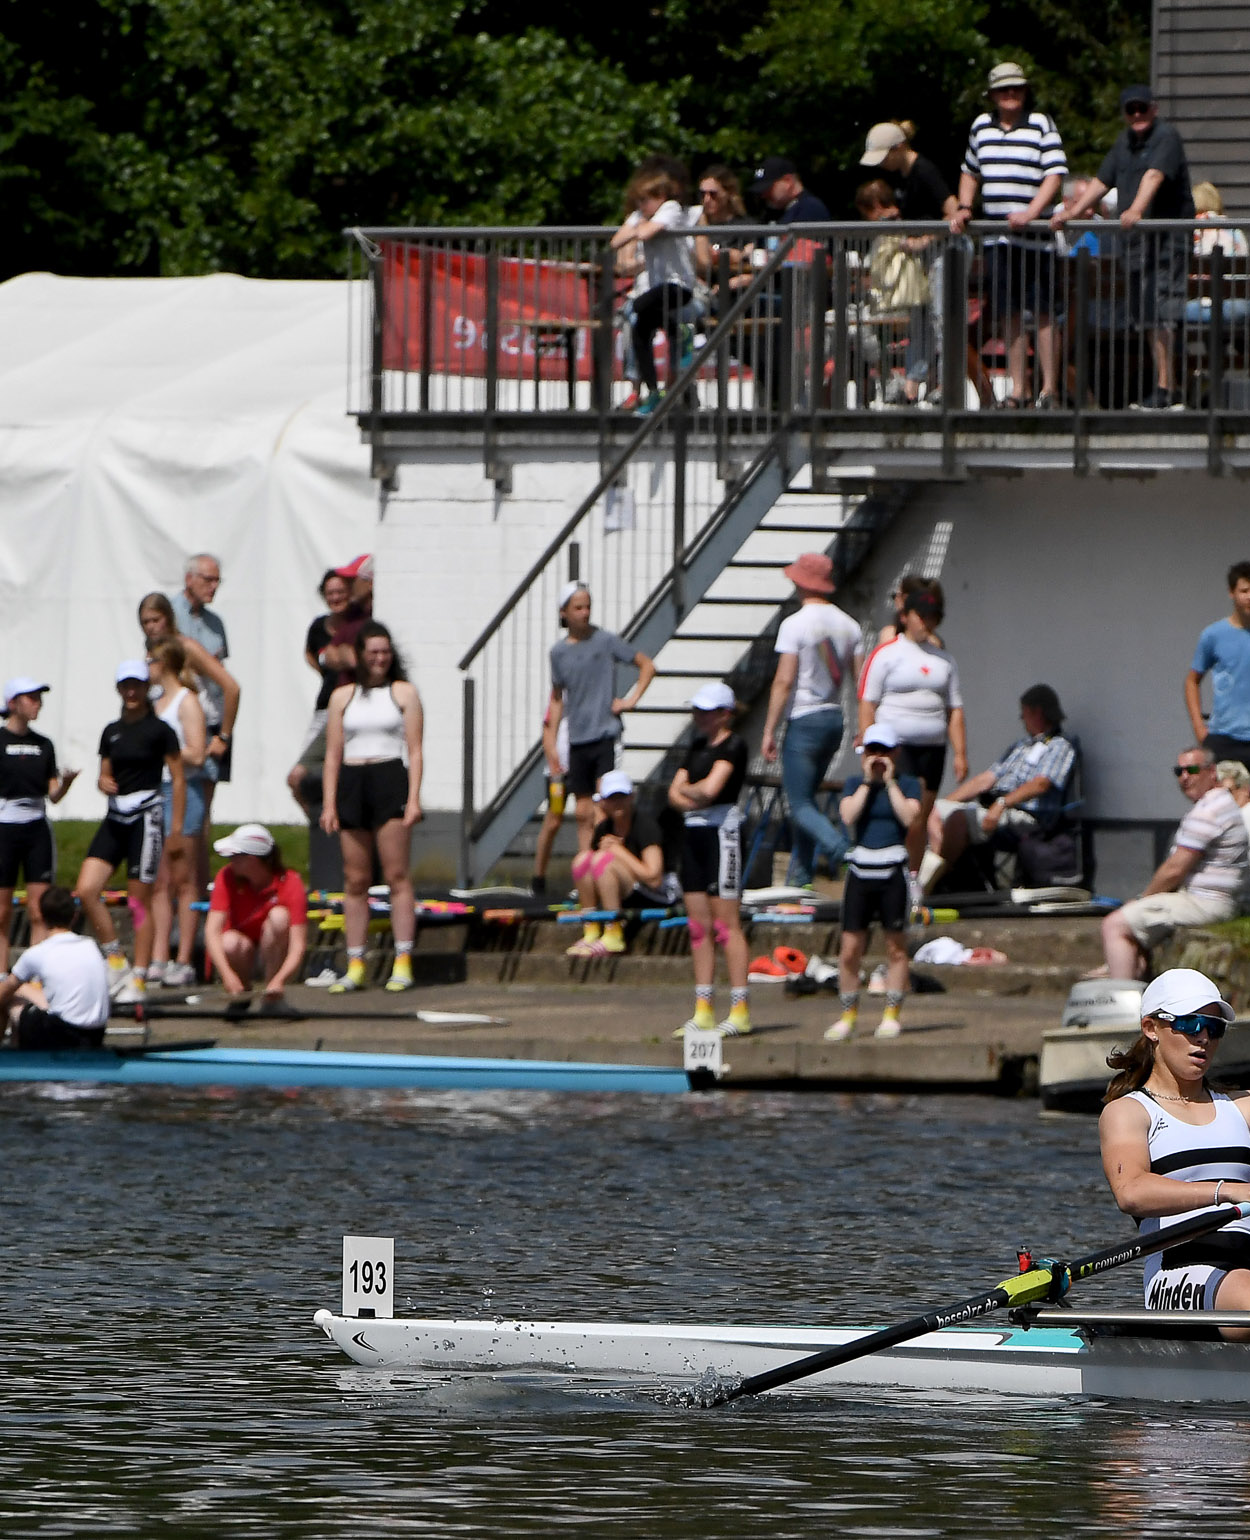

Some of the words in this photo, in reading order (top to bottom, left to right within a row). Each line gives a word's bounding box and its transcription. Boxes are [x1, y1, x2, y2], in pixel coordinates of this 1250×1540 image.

[690, 1041, 716, 1059] 207
[1094, 1250, 1133, 1271] concept
[1134, 1246, 1141, 1256] 2
[349, 1260, 387, 1295] 193
[1148, 1272, 1206, 1310] Minden
[936, 1298, 998, 1329] besselrc.de
